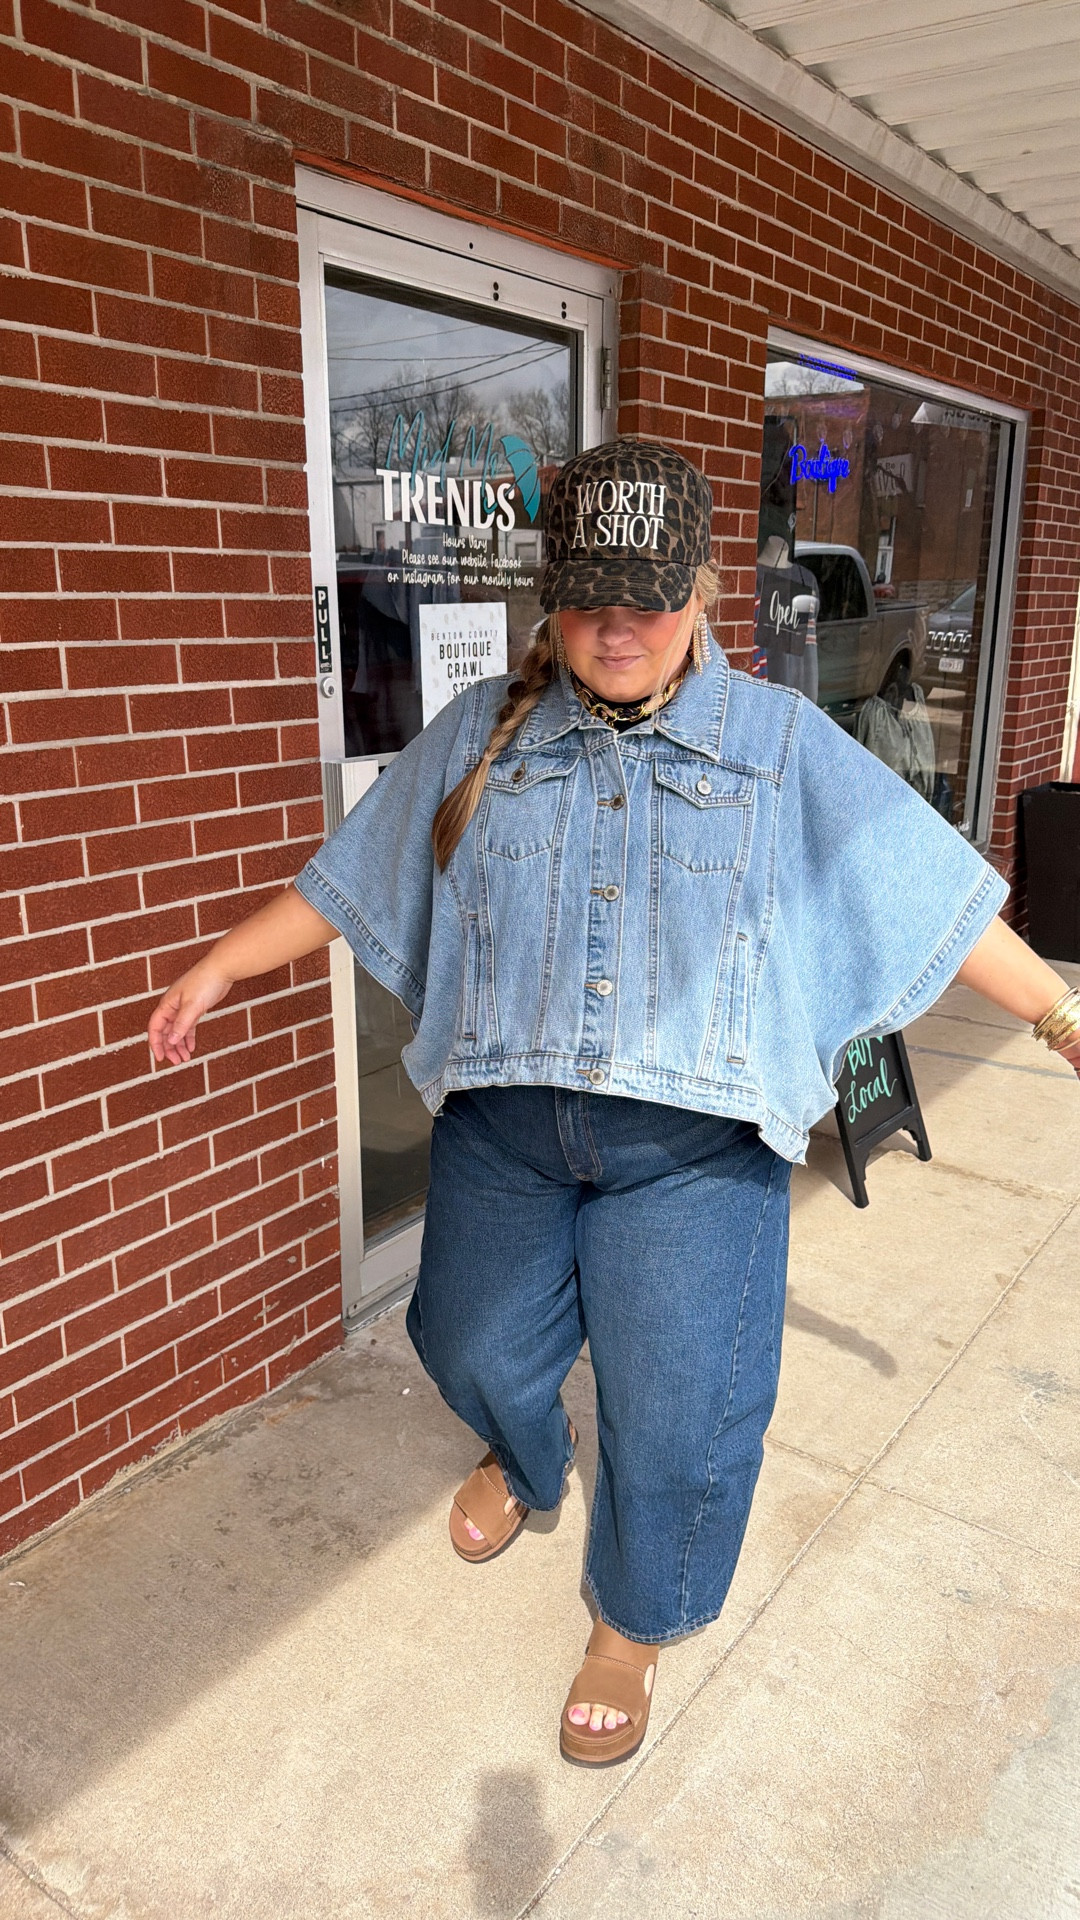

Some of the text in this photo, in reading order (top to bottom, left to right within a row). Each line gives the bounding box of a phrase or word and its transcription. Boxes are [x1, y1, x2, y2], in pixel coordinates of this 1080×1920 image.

[385, 409, 457, 492] Mid
[789, 438, 850, 494] Boutique
[376, 468, 515, 532] TRENDS
[576, 480, 666, 517] WORTH
[442, 532, 488, 553] Hours Vary
[571, 514, 664, 549] A SHOT
[401, 548, 425, 565] Please
[427, 555, 440, 565] see
[441, 556, 459, 566] our
[490, 554, 522, 569] Facebook
[387, 568, 535, 590] or Instagram for our monthly hours
[317, 590, 330, 660] PULL
[769, 590, 801, 635] Open
[430, 629, 498, 641] BENTON COUNTY
[439, 641, 492, 660] BOUTIQUE
[447, 660, 484, 679] CRAWL
[843, 1056, 898, 1124] Local
